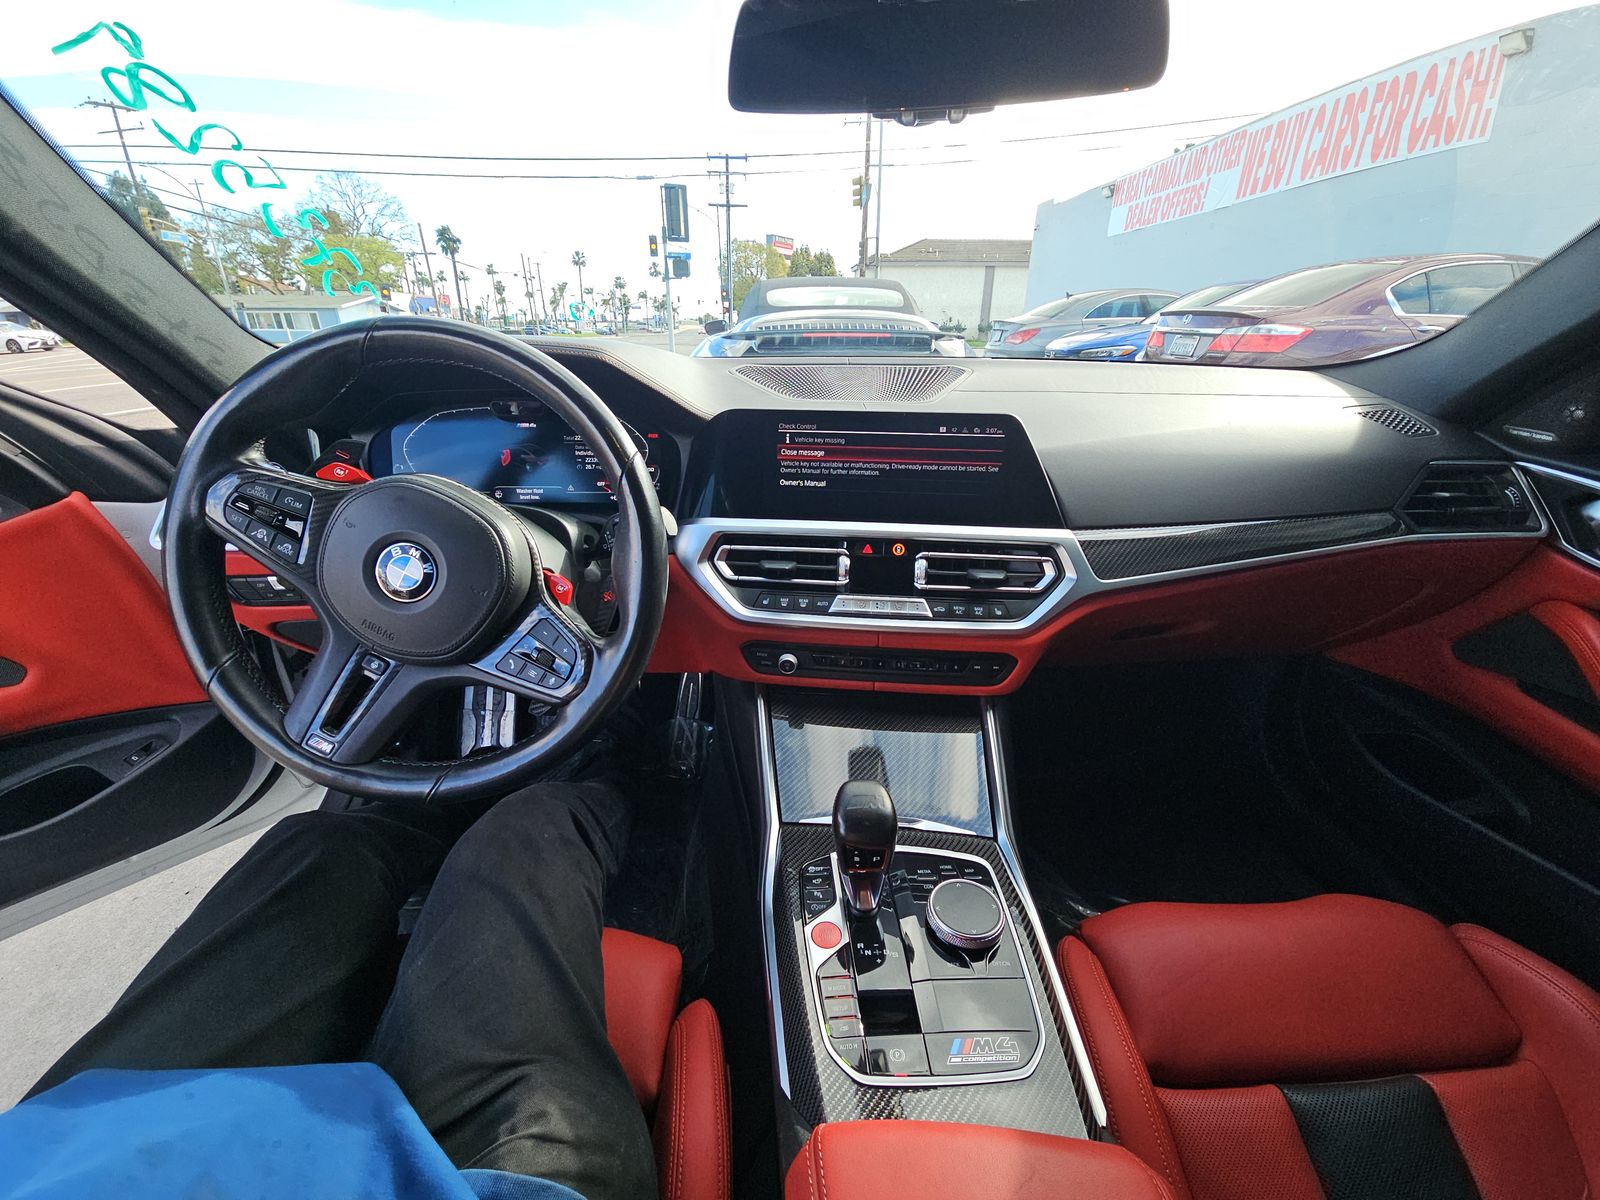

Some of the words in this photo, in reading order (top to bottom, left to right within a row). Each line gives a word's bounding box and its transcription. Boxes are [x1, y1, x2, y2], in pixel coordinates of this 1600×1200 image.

[1236, 124, 1273, 199] WE
[1260, 108, 1313, 193] BUY
[1300, 86, 1368, 181] CARS
[1354, 70, 1417, 168] FOR
[1407, 44, 1504, 154] CASH!
[1112, 178, 1127, 208] WE
[1124, 168, 1149, 204] BEAT
[1144, 153, 1187, 195] CARMAX
[1183, 145, 1209, 184] AND
[1206, 129, 1247, 177] OTHER
[1124, 195, 1162, 231] DEALER
[1161, 177, 1211, 221] OFFERS!
[778, 422, 796, 430] Check
[814, 437, 824, 445] key
[780, 448, 798, 456] Close
[798, 449, 825, 457] message
[850, 462, 890, 470] malfunctioning.
[891, 463, 921, 471] Drive-ready
[779, 478, 804, 487] Owner's
[804, 479, 827, 487] Manual
[290, 501, 303, 509] LIM
[231, 514, 243, 523] SET
[390, 546, 434, 574] BMW
[360, 618, 396, 641] AIRBAG
